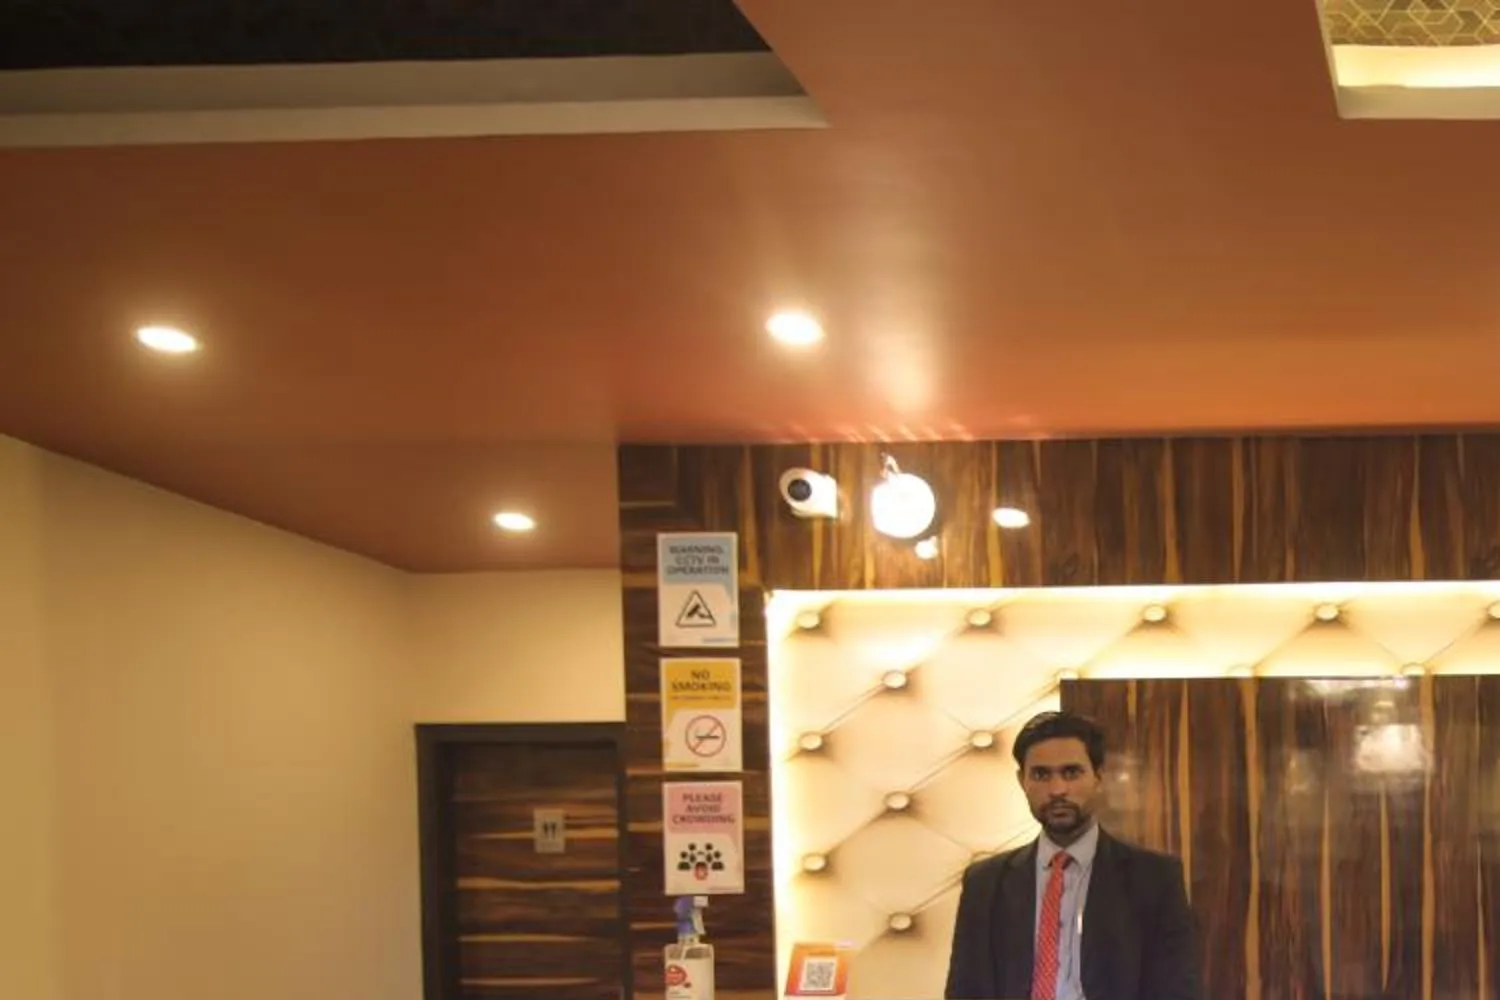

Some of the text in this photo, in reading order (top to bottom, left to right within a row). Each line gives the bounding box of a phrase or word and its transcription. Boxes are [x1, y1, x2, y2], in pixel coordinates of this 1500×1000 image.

[666, 565, 729, 576] OPERATION
[690, 670, 711, 681] NO
[671, 680, 732, 693] SMOKING
[682, 793, 723, 804] PLEASE
[684, 803, 721, 814] AVOID
[672, 813, 736, 826] CROWDING
